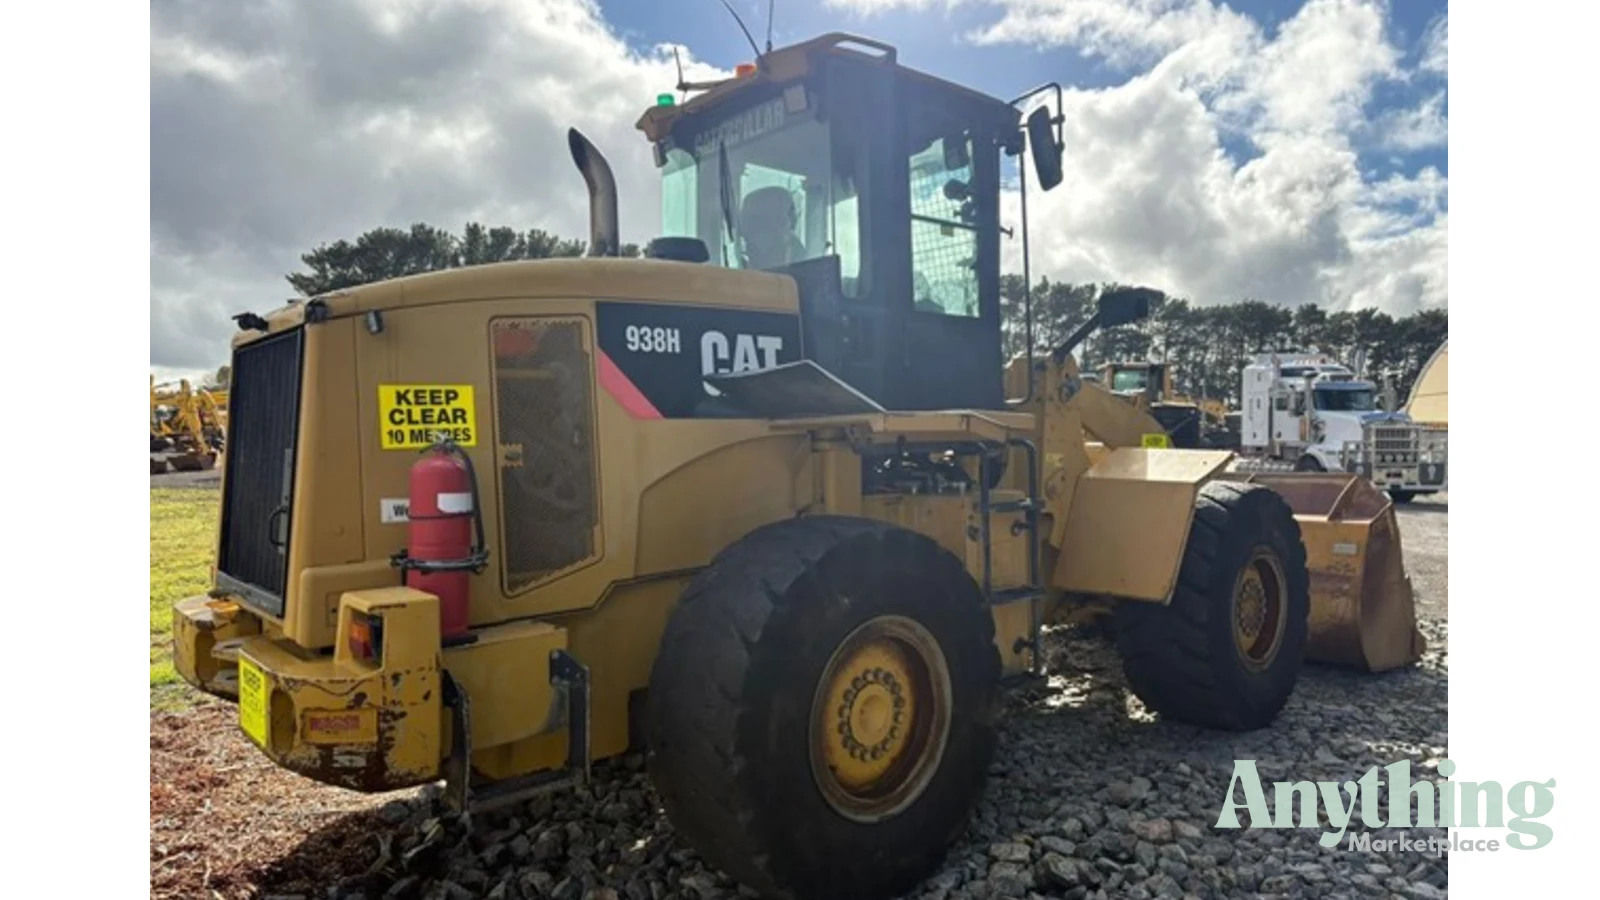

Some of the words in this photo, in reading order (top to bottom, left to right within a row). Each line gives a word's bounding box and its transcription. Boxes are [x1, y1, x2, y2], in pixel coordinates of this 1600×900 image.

[625, 325, 681, 353] 938H
[701, 330, 783, 396] CAT
[395, 389, 459, 406] KEEP
[388, 408, 468, 425] CLEAR
[387, 429, 405, 444] 10
[409, 428, 472, 443] MERES
